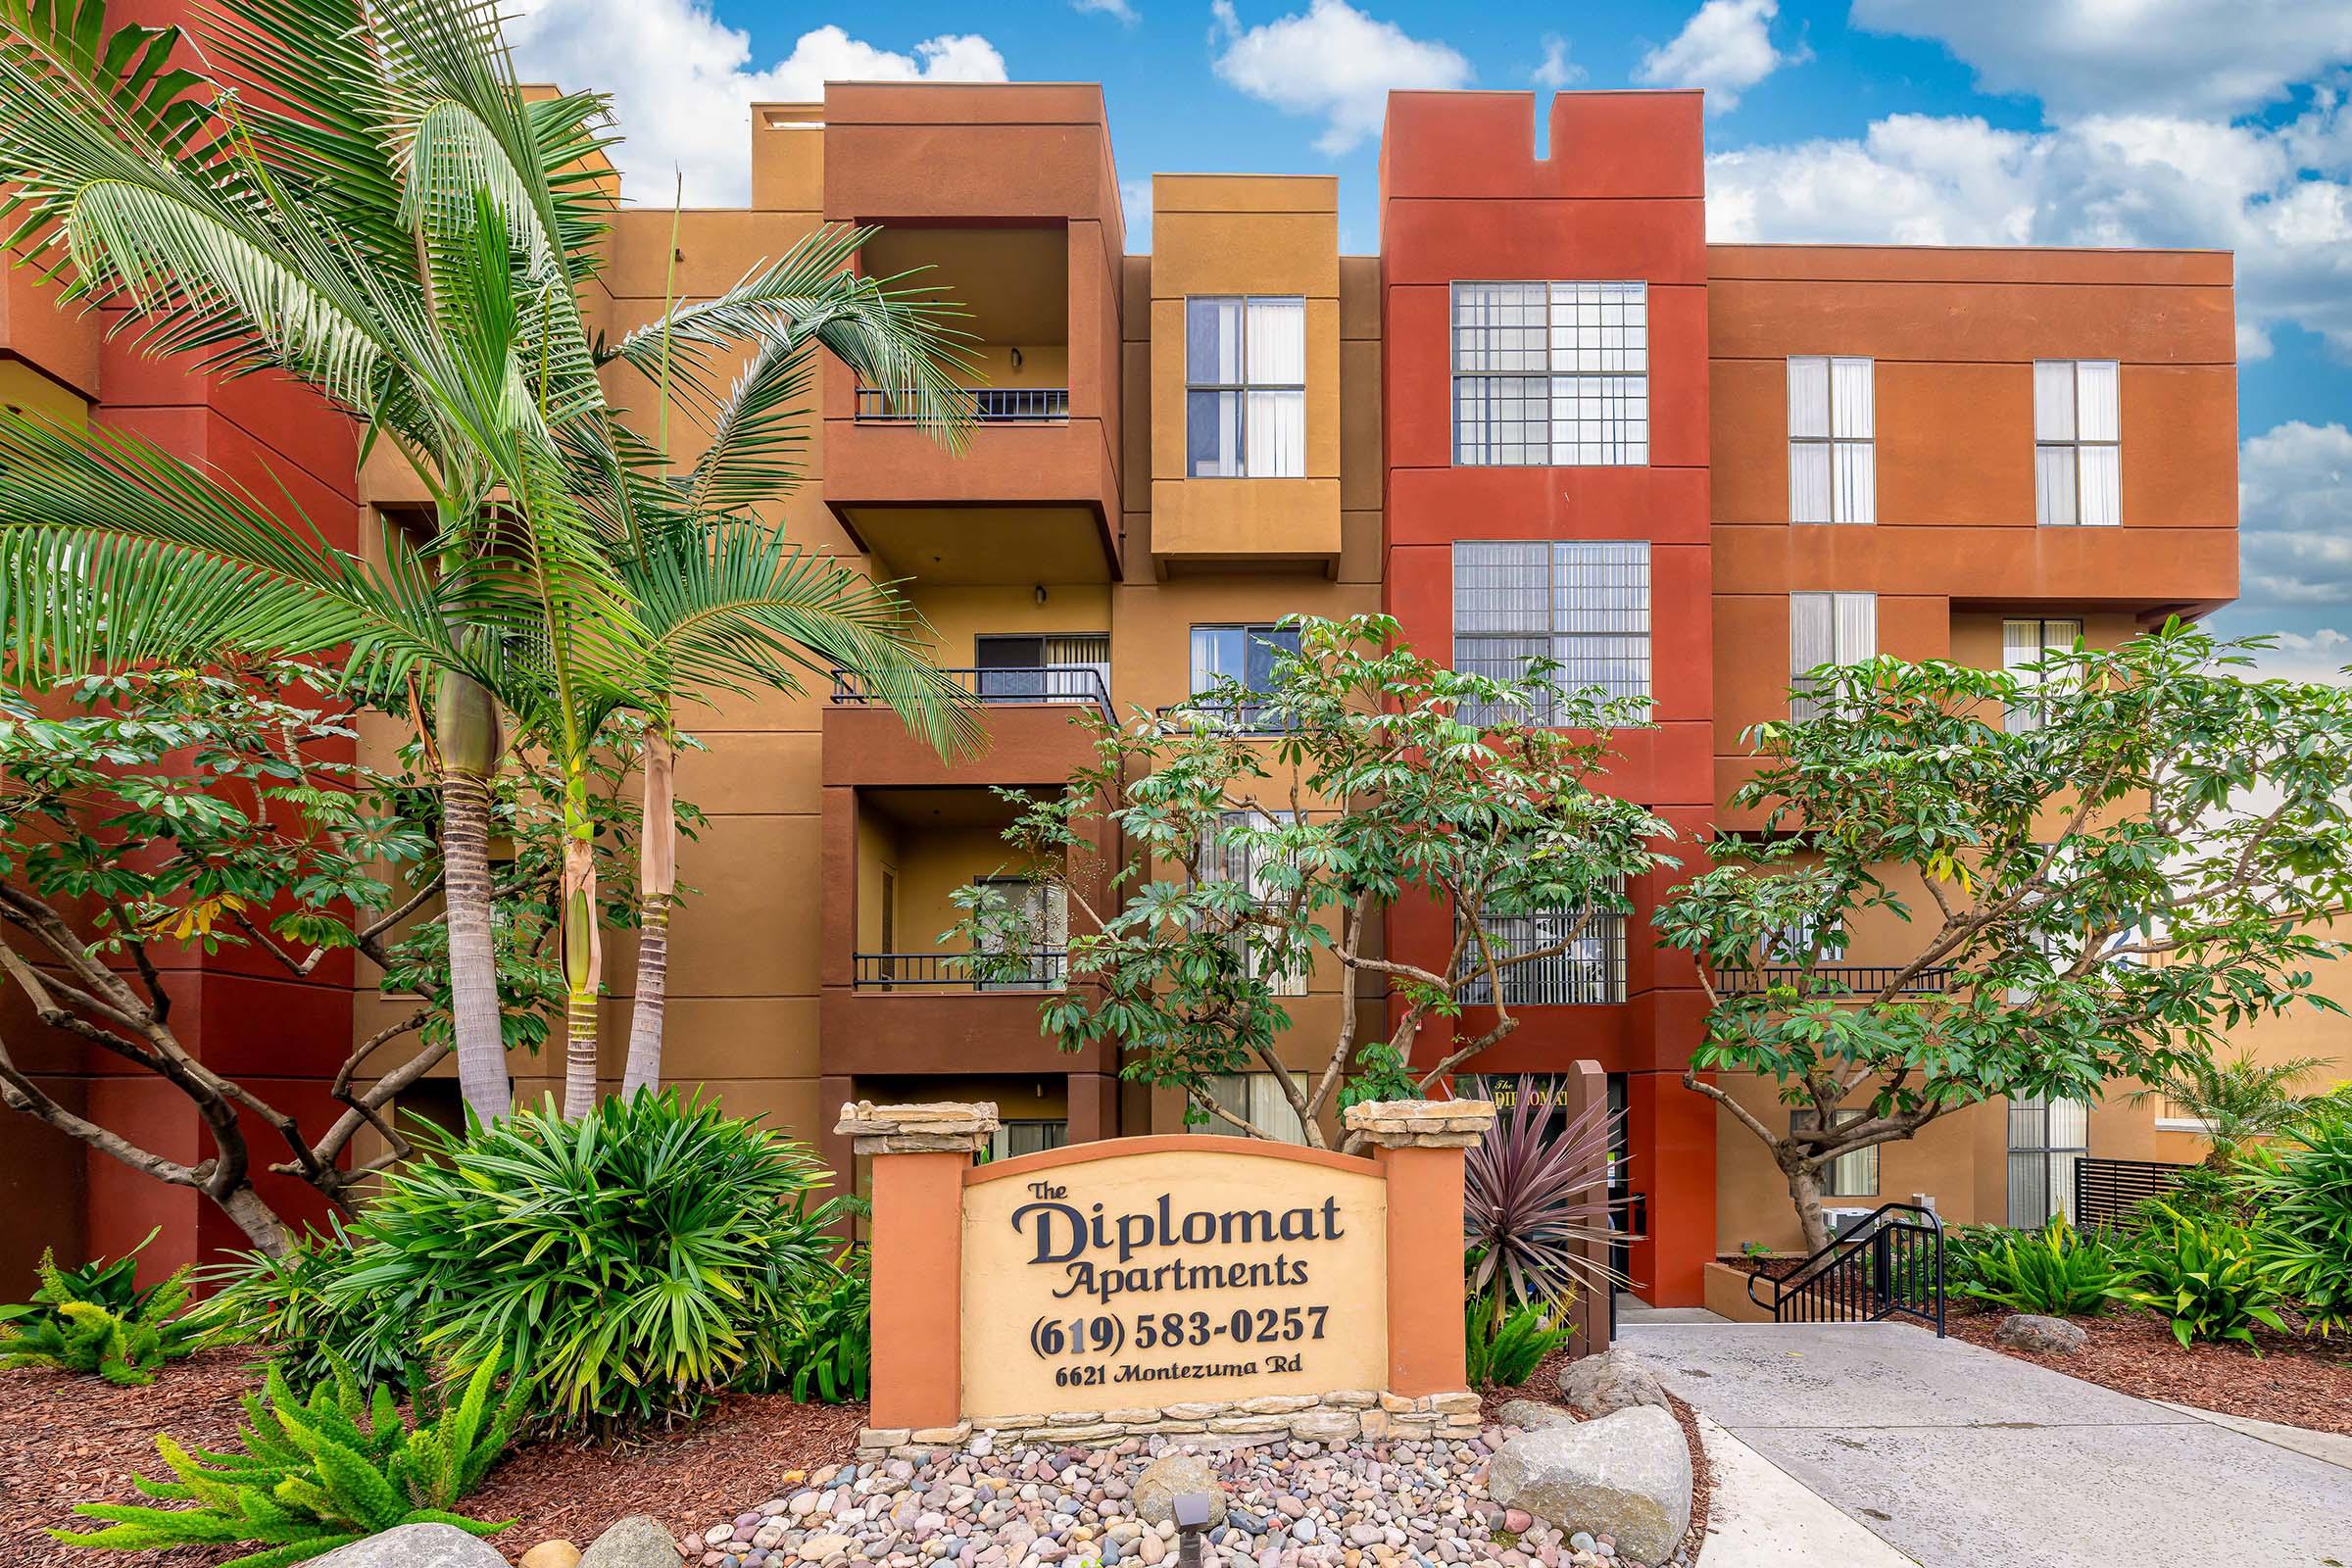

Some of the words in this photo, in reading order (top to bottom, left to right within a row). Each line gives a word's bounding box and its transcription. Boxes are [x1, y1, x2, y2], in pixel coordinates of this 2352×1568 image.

[1494, 1080, 1514, 1090] The
[1027, 1180, 1068, 1200] The
[1010, 1193, 1345, 1265] Diplomat
[1052, 1253, 1309, 1305] Apartments
[1030, 1313, 1126, 1360] (619)
[1135, 1305, 1330, 1349] 583-0257
[1055, 1364, 1105, 1388] 6621
[1113, 1361, 1258, 1384] Montezuma
[1264, 1352, 1303, 1374] Rd
